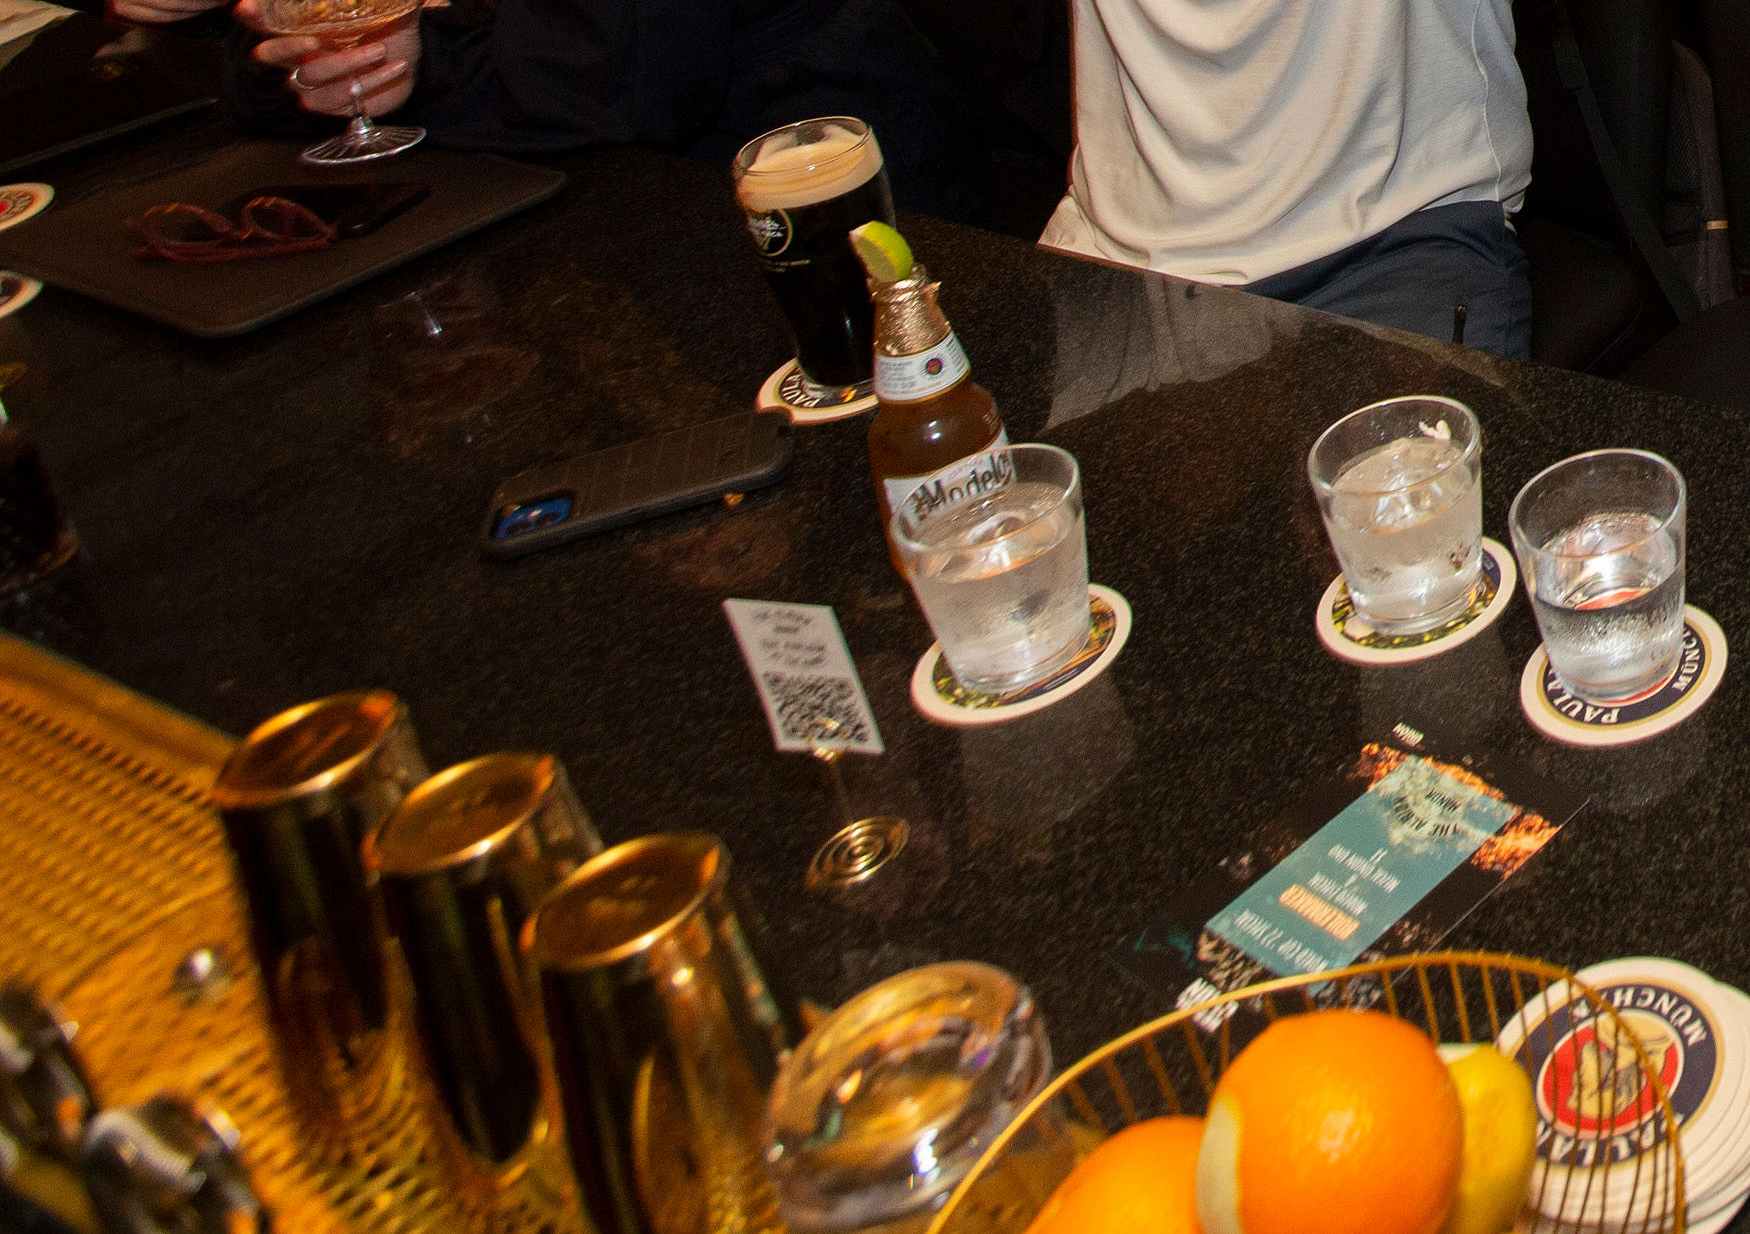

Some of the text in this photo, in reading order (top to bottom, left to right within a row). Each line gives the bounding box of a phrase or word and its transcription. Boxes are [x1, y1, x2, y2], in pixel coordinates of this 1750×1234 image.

[780, 366, 820, 408] PAULA
[919, 450, 1010, 505] Modelo
[1546, 663, 1621, 725] PAULA
[1278, 882, 1361, 942] BOILERMAKER
[1572, 985, 1708, 1047] MÜNCHN
